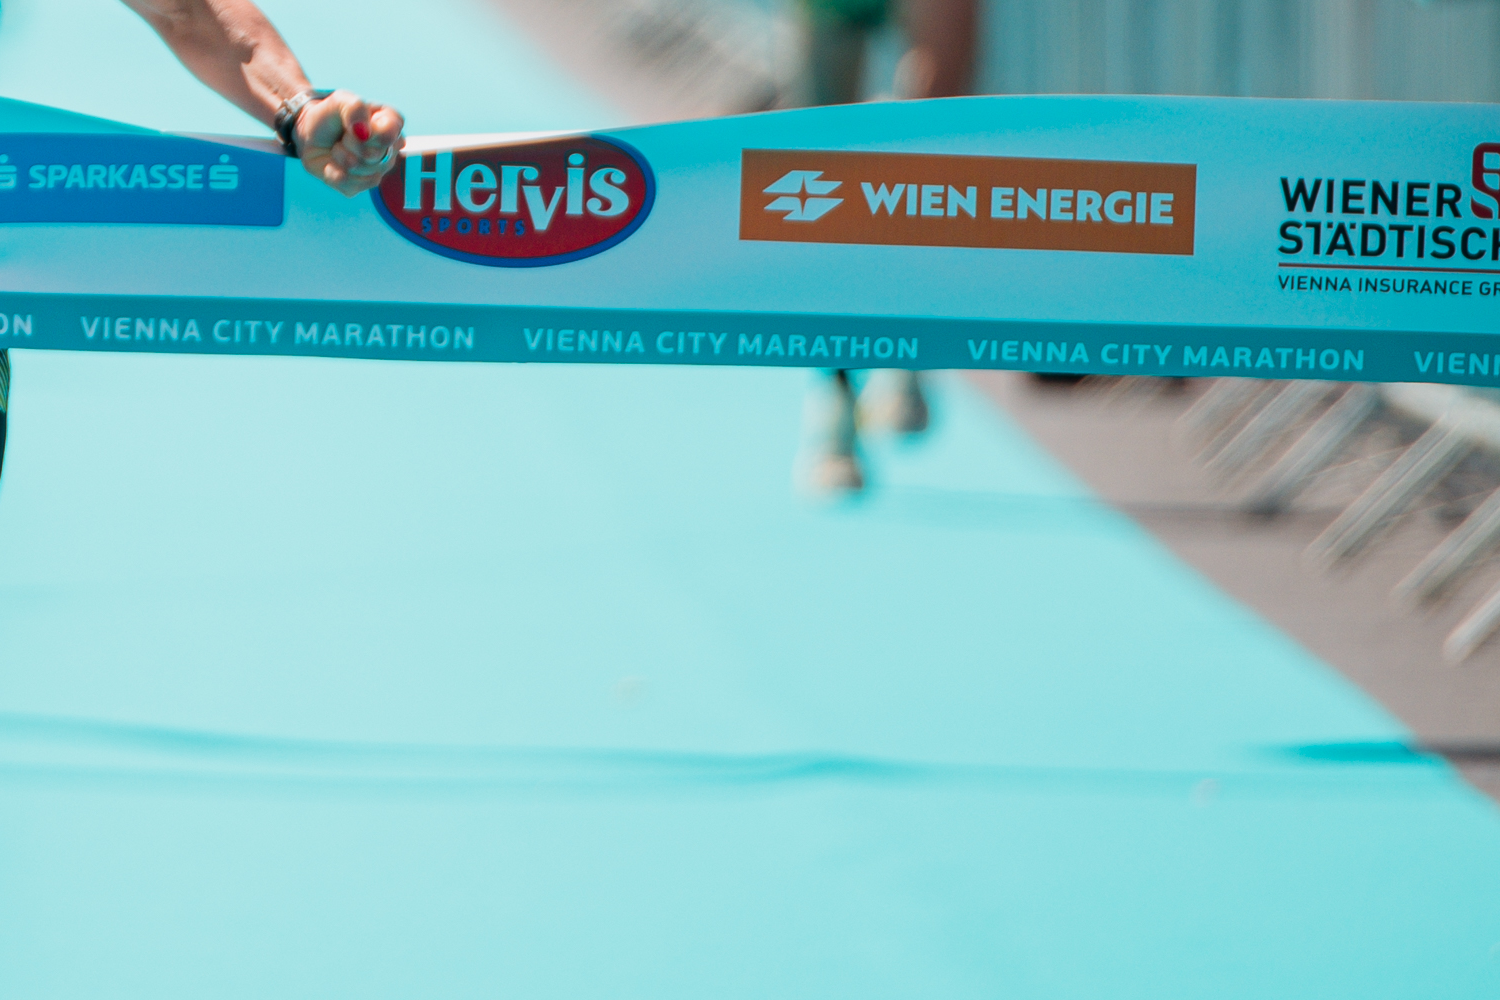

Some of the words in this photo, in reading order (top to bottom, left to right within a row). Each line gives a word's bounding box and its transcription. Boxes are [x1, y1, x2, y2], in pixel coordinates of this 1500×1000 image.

[27, 163, 205, 190] SPARKASSE
[403, 150, 630, 232] Hervis
[860, 181, 977, 218] WIEN
[990, 186, 1174, 225] ENERGIE
[1280, 177, 1462, 218] WIENER
[421, 216, 526, 237] SPORTS
[1278, 275, 1352, 292] VIENNA
[1358, 278, 1473, 296] INSURANCE
[80, 315, 201, 342] VIENNA
[212, 319, 285, 345] CITY
[294, 321, 475, 349] MARATHON
[523, 327, 645, 354] VIENNA
[655, 331, 728, 357] CITY
[737, 333, 919, 361] MARATHON
[967, 339, 1090, 364] VIENNA
[1100, 343, 1174, 368] CITY
[1183, 345, 1365, 372] MARATHON
